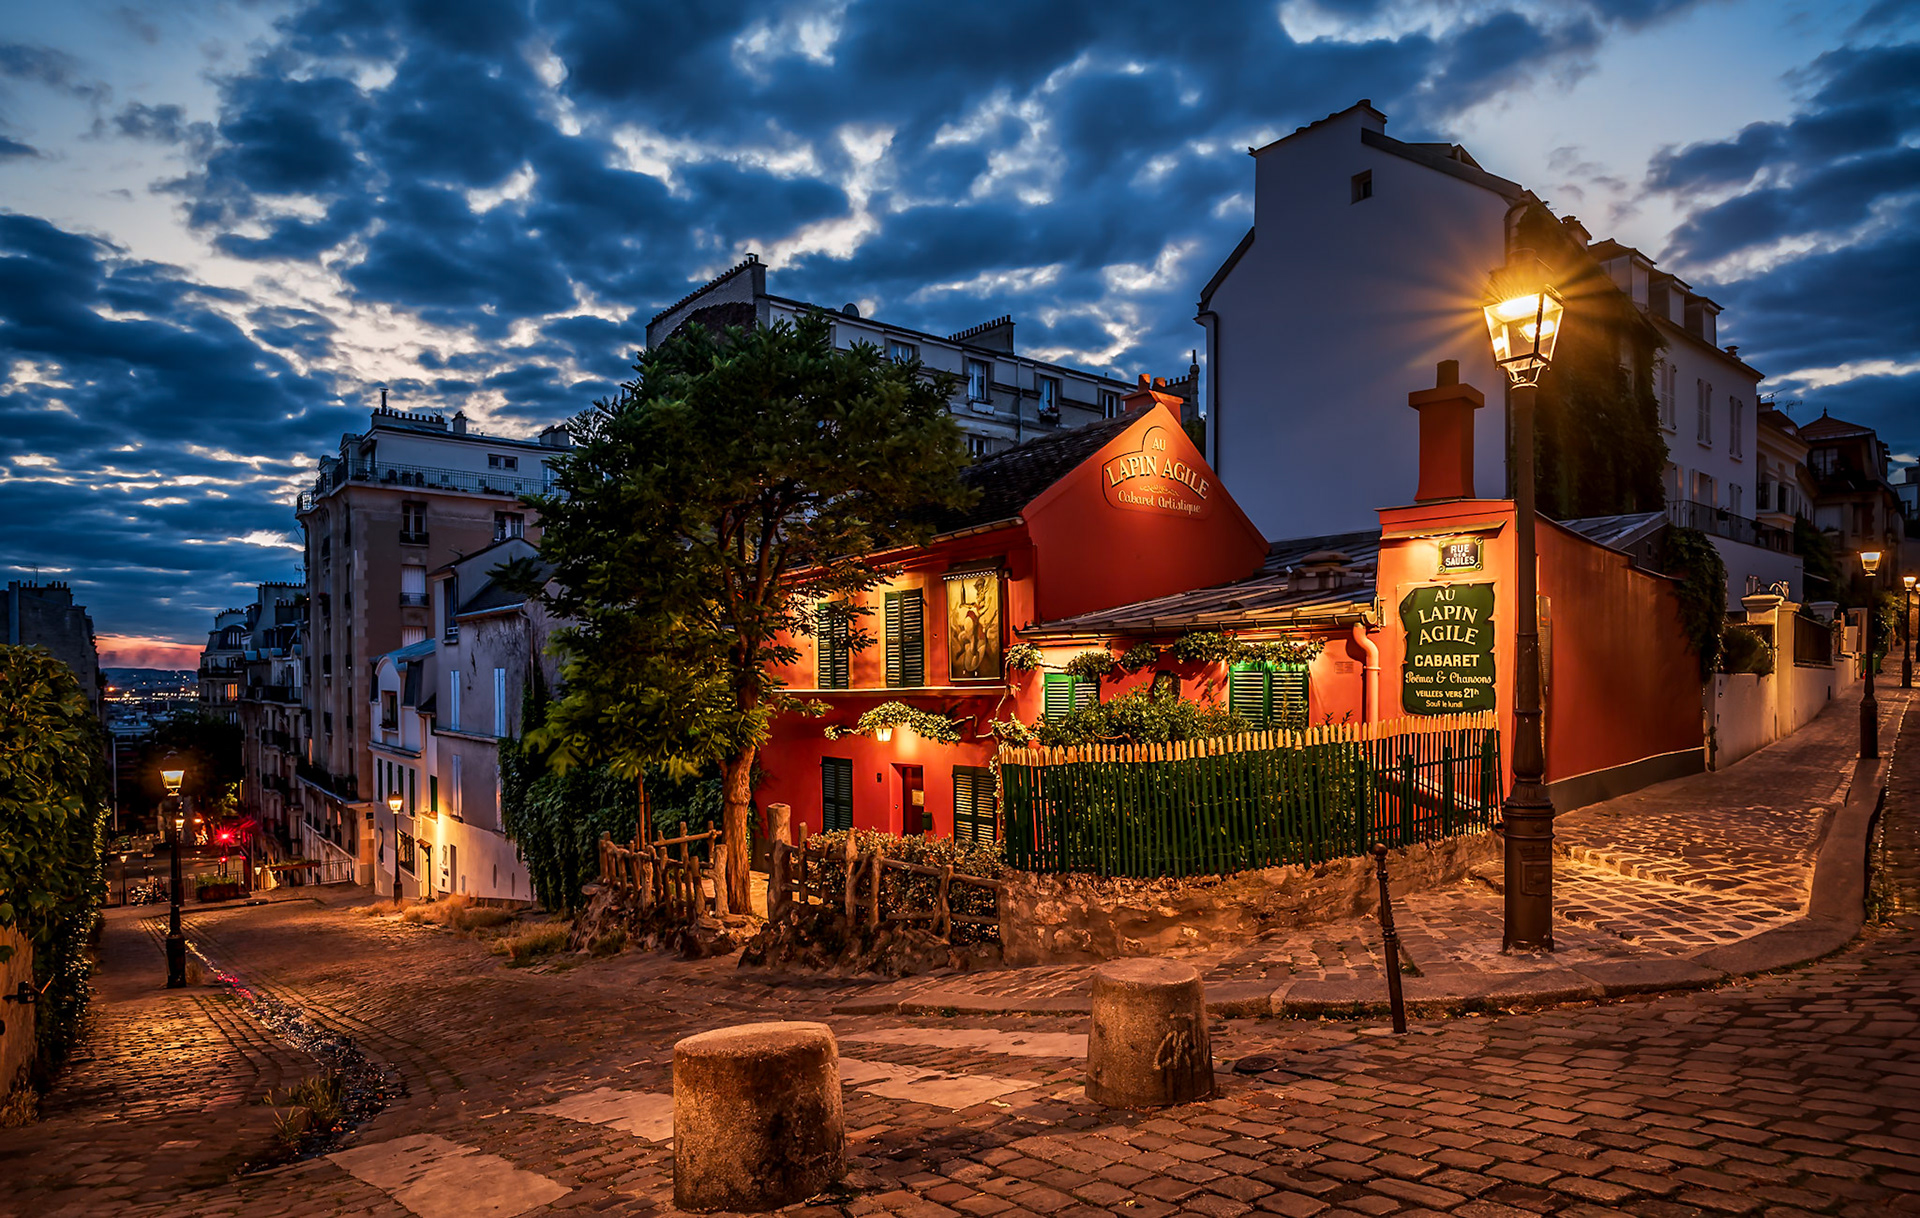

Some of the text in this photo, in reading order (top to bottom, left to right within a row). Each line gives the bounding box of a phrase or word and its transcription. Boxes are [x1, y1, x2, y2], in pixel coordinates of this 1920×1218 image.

[1152, 438, 1166, 451] AU
[1106, 455, 1209, 499] LAPIN AGILE
[1118, 490, 1155, 506] Cabaret
[1450, 544, 1470, 554] RUE
[1445, 556, 1475, 567] SAULES
[1434, 590, 1456, 602] AU
[1418, 605, 1478, 624] LAPIN
[1419, 625, 1479, 646] AGILE
[1414, 654, 1480, 667] CABARET
[1436, 670, 1447, 684] &
[1449, 671, 1492, 684] Chansons
[1445, 690, 1463, 698] VERS
[1425, 700, 1440, 708] Sauf
